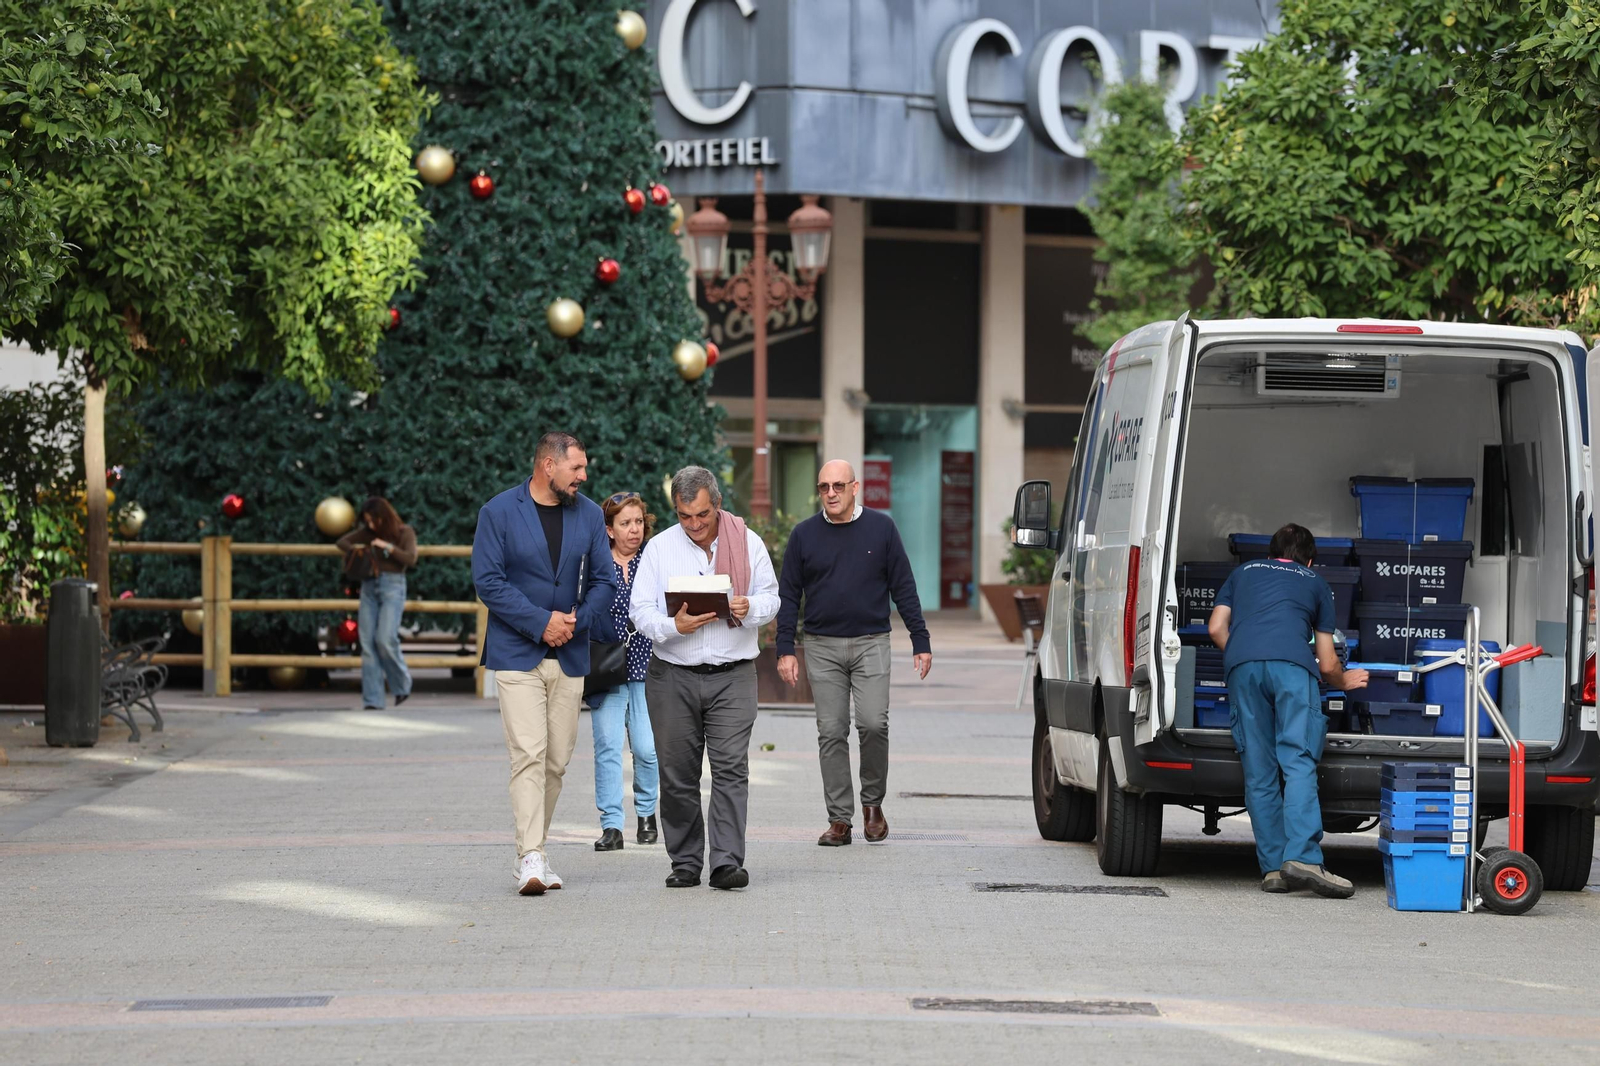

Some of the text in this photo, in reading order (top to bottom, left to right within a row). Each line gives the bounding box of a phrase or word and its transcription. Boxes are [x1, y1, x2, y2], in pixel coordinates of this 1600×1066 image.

[654, 137, 776, 168] ORTEFIEL
[1392, 564, 1446, 577] COFARES
[1179, 587, 1216, 599] FARES
[1393, 626, 1446, 639] COFARES
